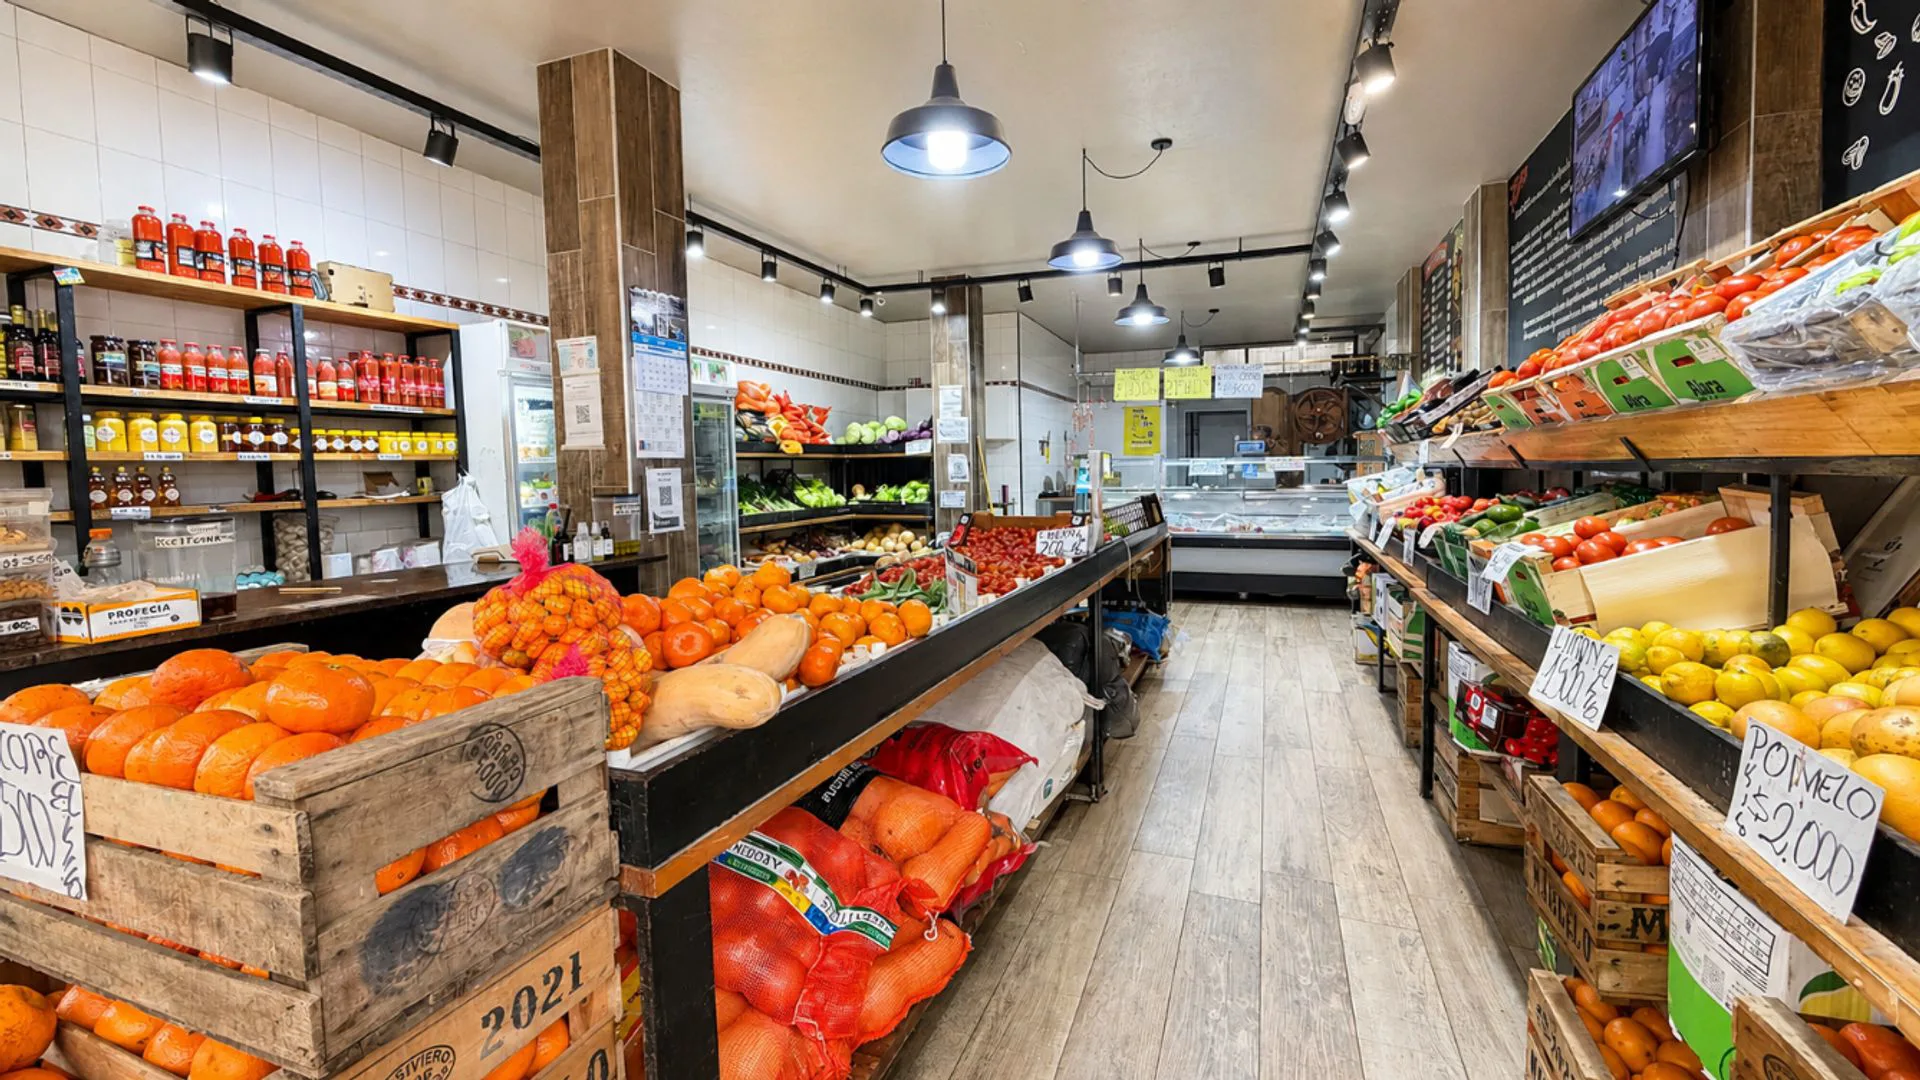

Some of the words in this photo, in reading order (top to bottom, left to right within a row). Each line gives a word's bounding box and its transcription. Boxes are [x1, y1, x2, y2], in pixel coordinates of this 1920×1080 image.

[107, 603, 171, 620] PROFECIA
[1750, 725, 1877, 820] POMELO
[480, 950, 584, 1060] 2021
